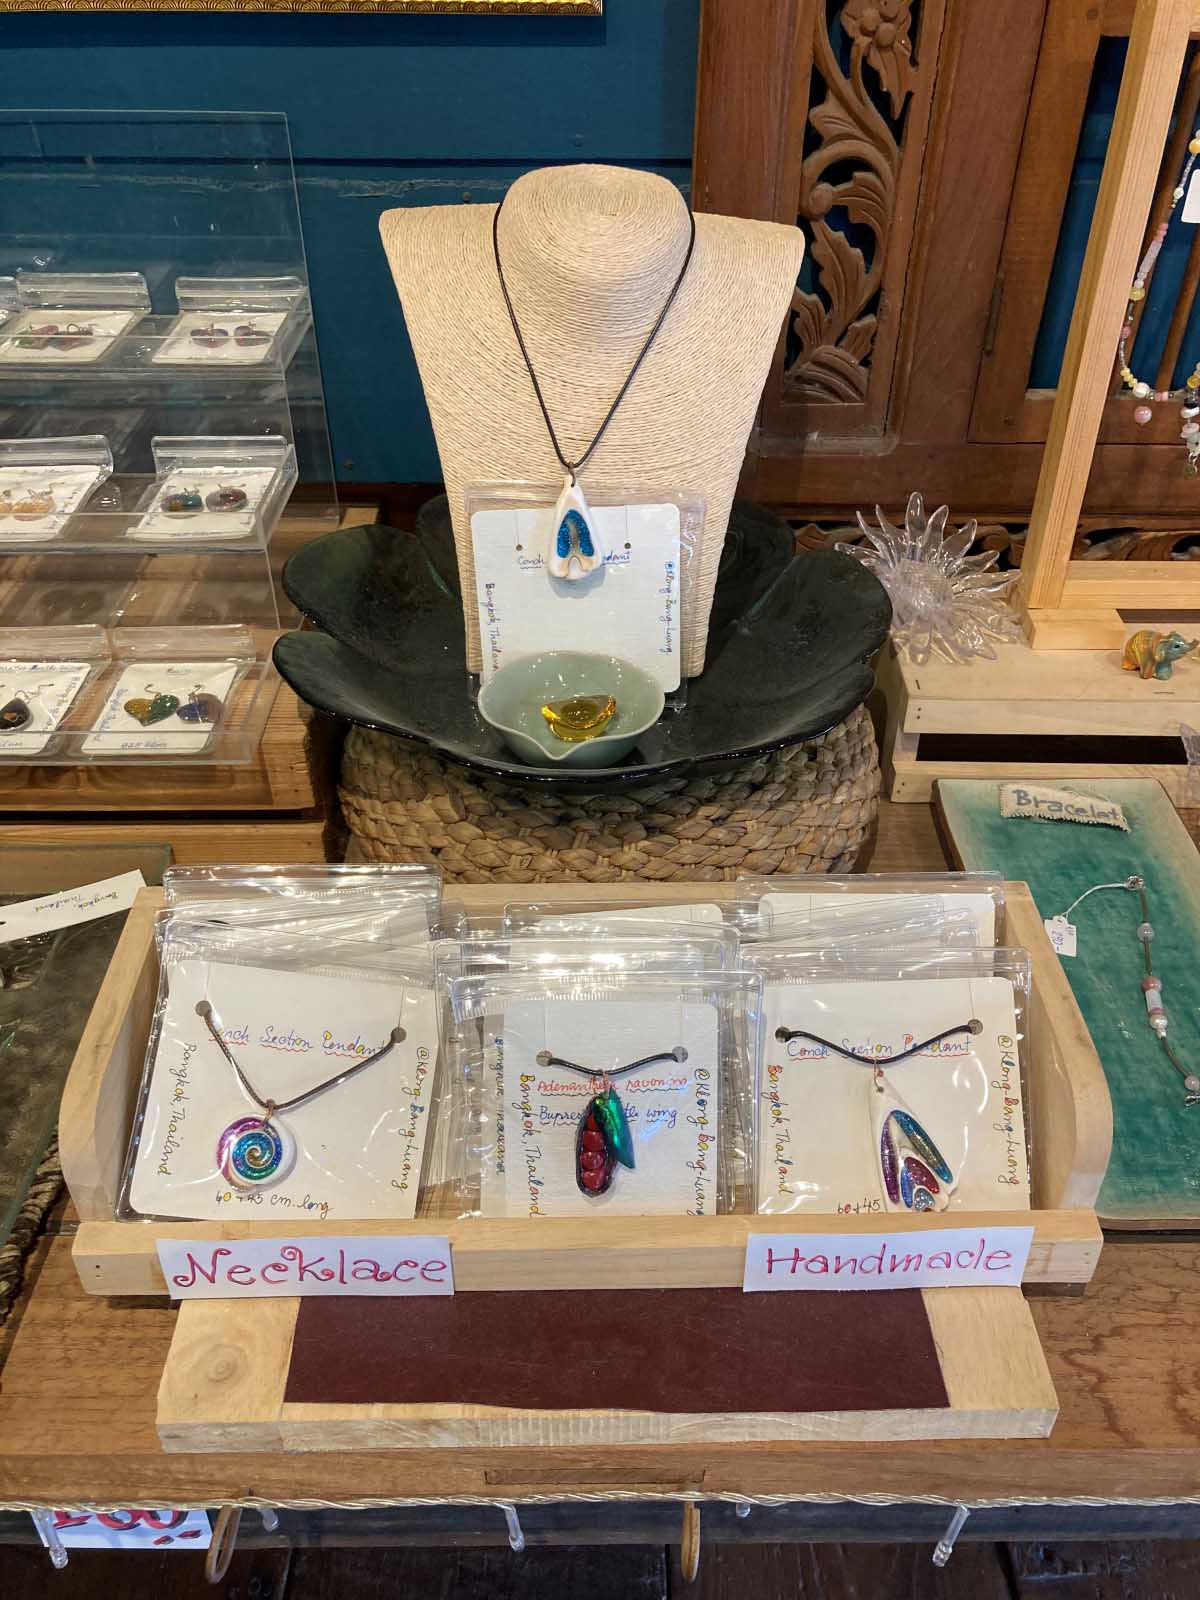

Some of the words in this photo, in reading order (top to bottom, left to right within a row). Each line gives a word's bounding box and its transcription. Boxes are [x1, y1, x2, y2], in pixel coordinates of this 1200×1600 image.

[260, 1025, 314, 1049] Section
[787, 1040, 830, 1057] Conch
[169, 1043, 197, 1106] Bangkok,
[761, 1065, 790, 1128] Bangkok,
[512, 1073, 541, 1144] Bangkok,
[647, 1109, 677, 1128] wing
[157, 1107, 187, 1176] Thailand
[775, 1129, 794, 1194] Thailand
[525, 1145, 547, 1217] Thailand
[173, 1245, 447, 1288] Necklace
[766, 1238, 1012, 1275] Handmade
